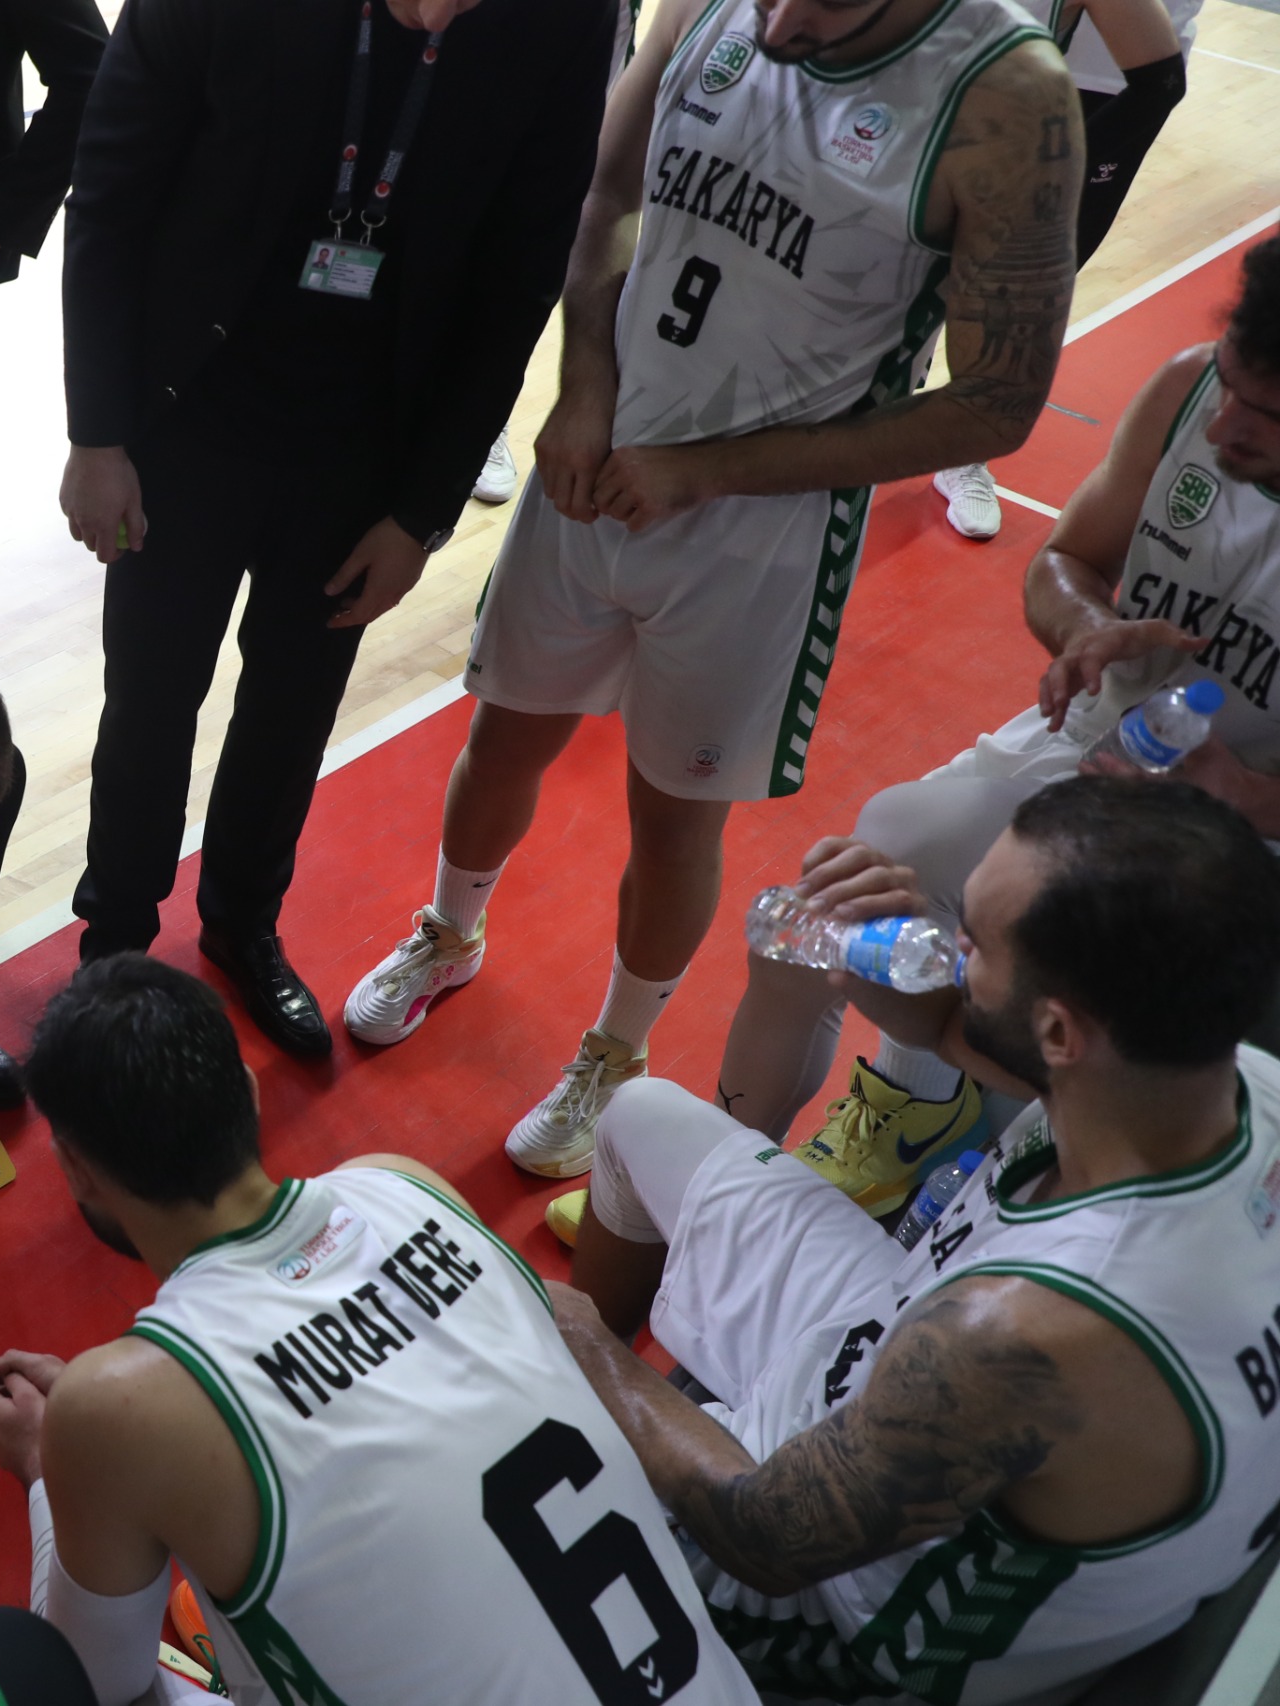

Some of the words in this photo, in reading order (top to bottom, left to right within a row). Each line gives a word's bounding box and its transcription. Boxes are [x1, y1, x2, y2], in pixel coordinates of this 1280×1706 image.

[709, 39, 749, 72] SBB
[676, 94, 722, 126] hummel
[649, 146, 815, 279] SAKARYA
[656, 255, 721, 347] 9
[1175, 472, 1213, 509] SBB
[1139, 519, 1192, 561] hummel
[253, 1281, 416, 1419] MURAT
[379, 1218, 483, 1320] DERE
[482, 1417, 699, 1706] 6
